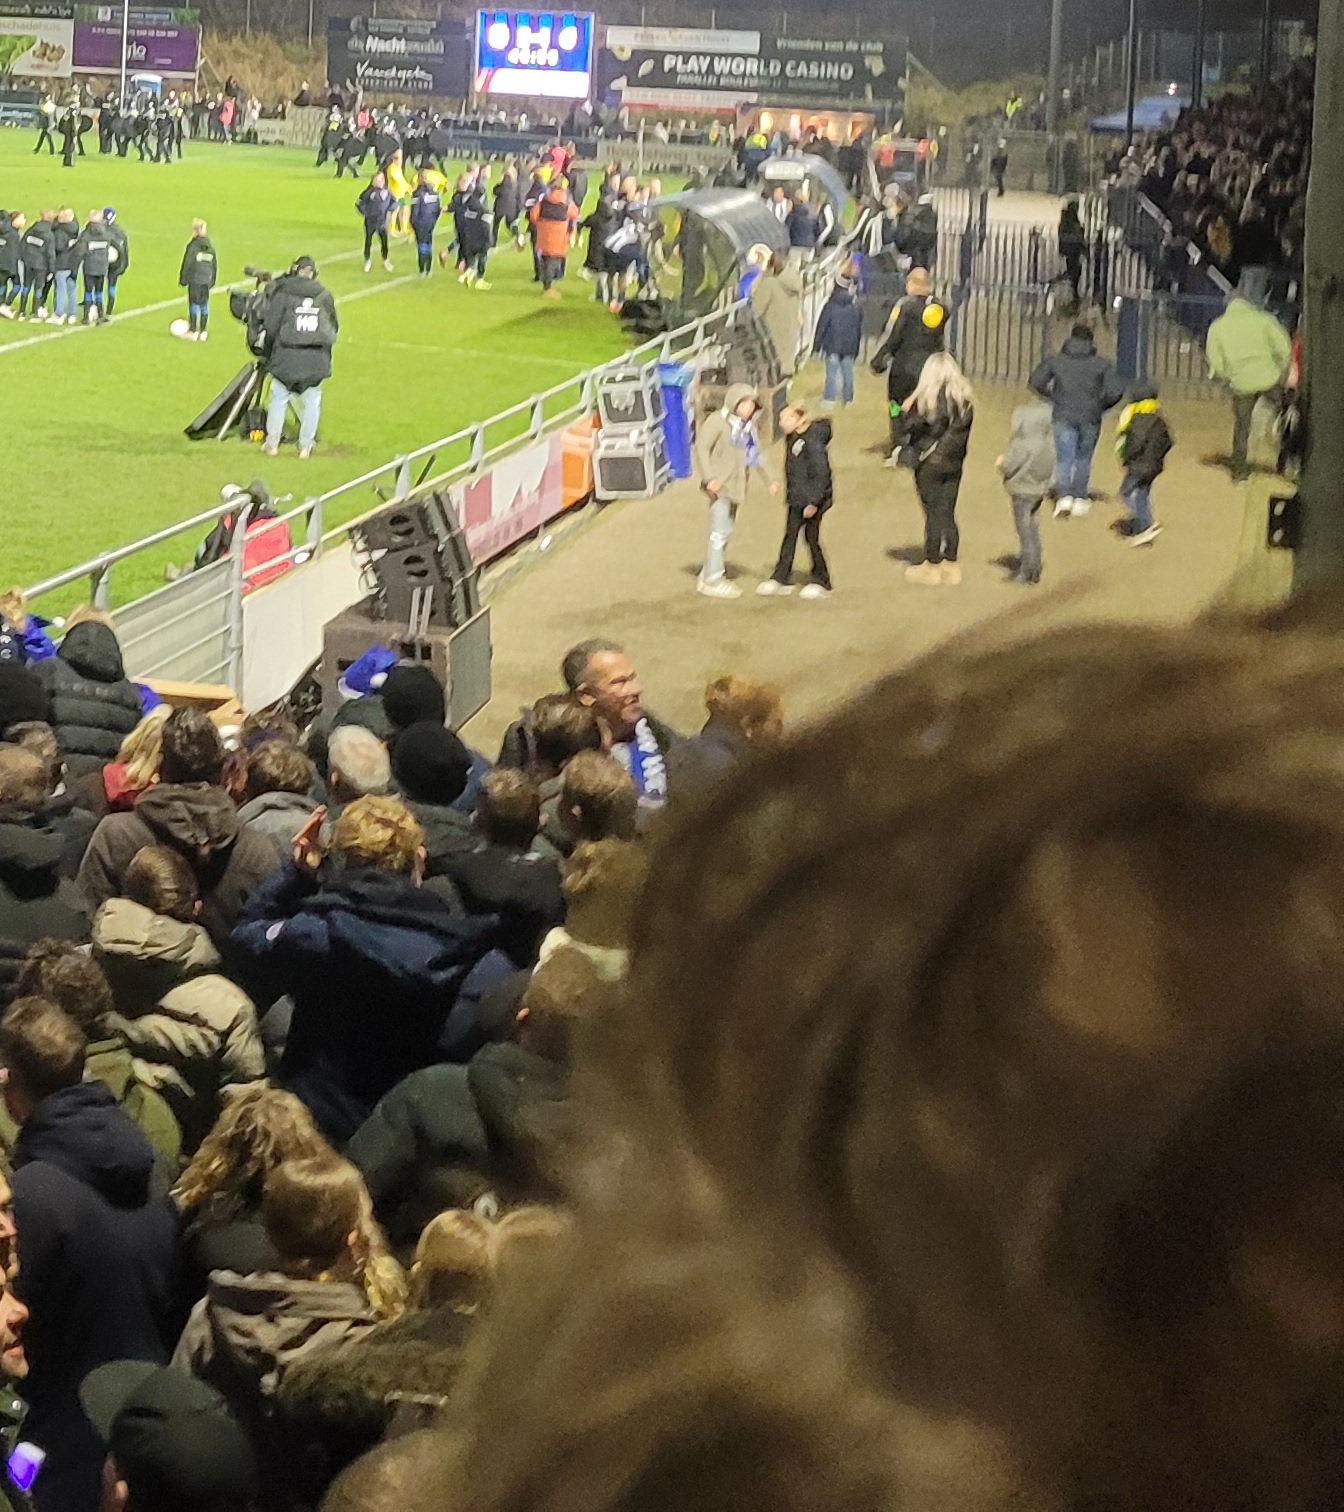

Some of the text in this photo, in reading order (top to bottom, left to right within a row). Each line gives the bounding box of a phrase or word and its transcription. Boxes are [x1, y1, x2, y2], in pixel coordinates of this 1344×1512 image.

[663, 54, 854, 82] PLAY WORLD CASINO
